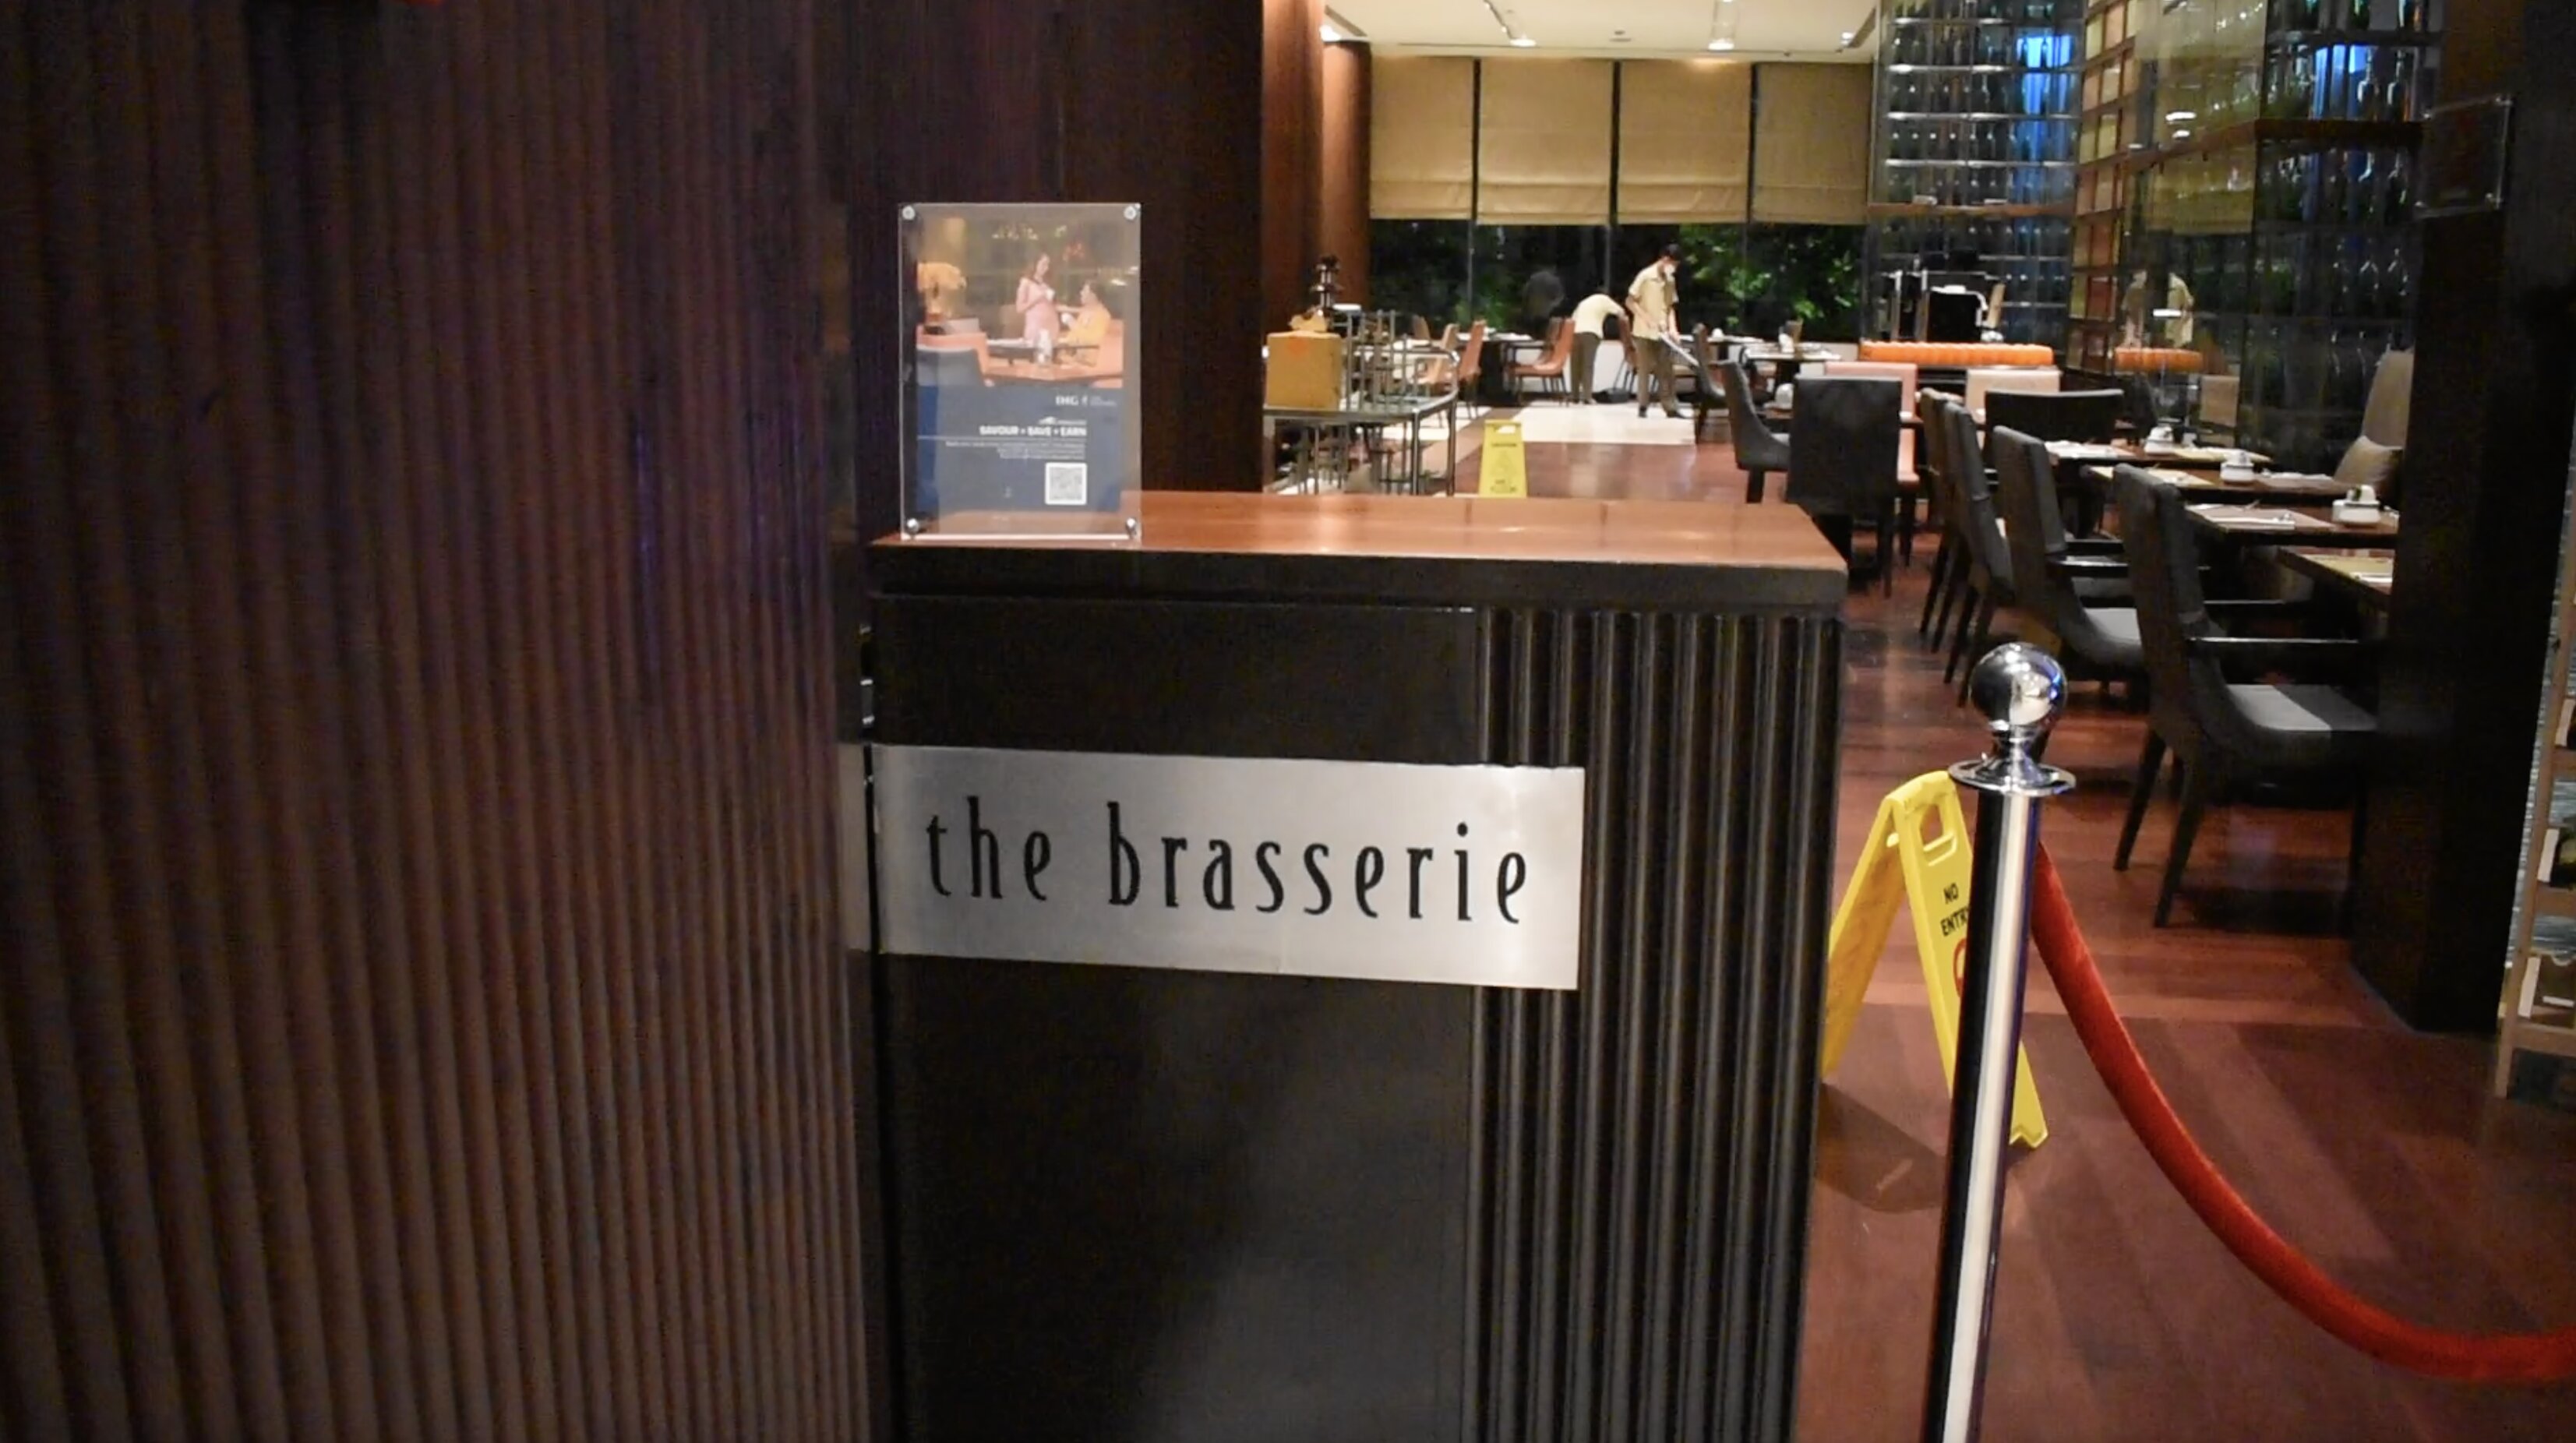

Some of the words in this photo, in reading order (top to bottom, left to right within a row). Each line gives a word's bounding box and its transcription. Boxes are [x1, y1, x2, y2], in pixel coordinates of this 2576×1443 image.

[979, 425, 1018, 436] SAVOUR
[1027, 426, 1051, 436] SAVE
[1060, 426, 1087, 436] EARN
[925, 795, 1052, 903] the
[1106, 800, 1527, 923] brasserie
[1943, 882, 1959, 905] NO
